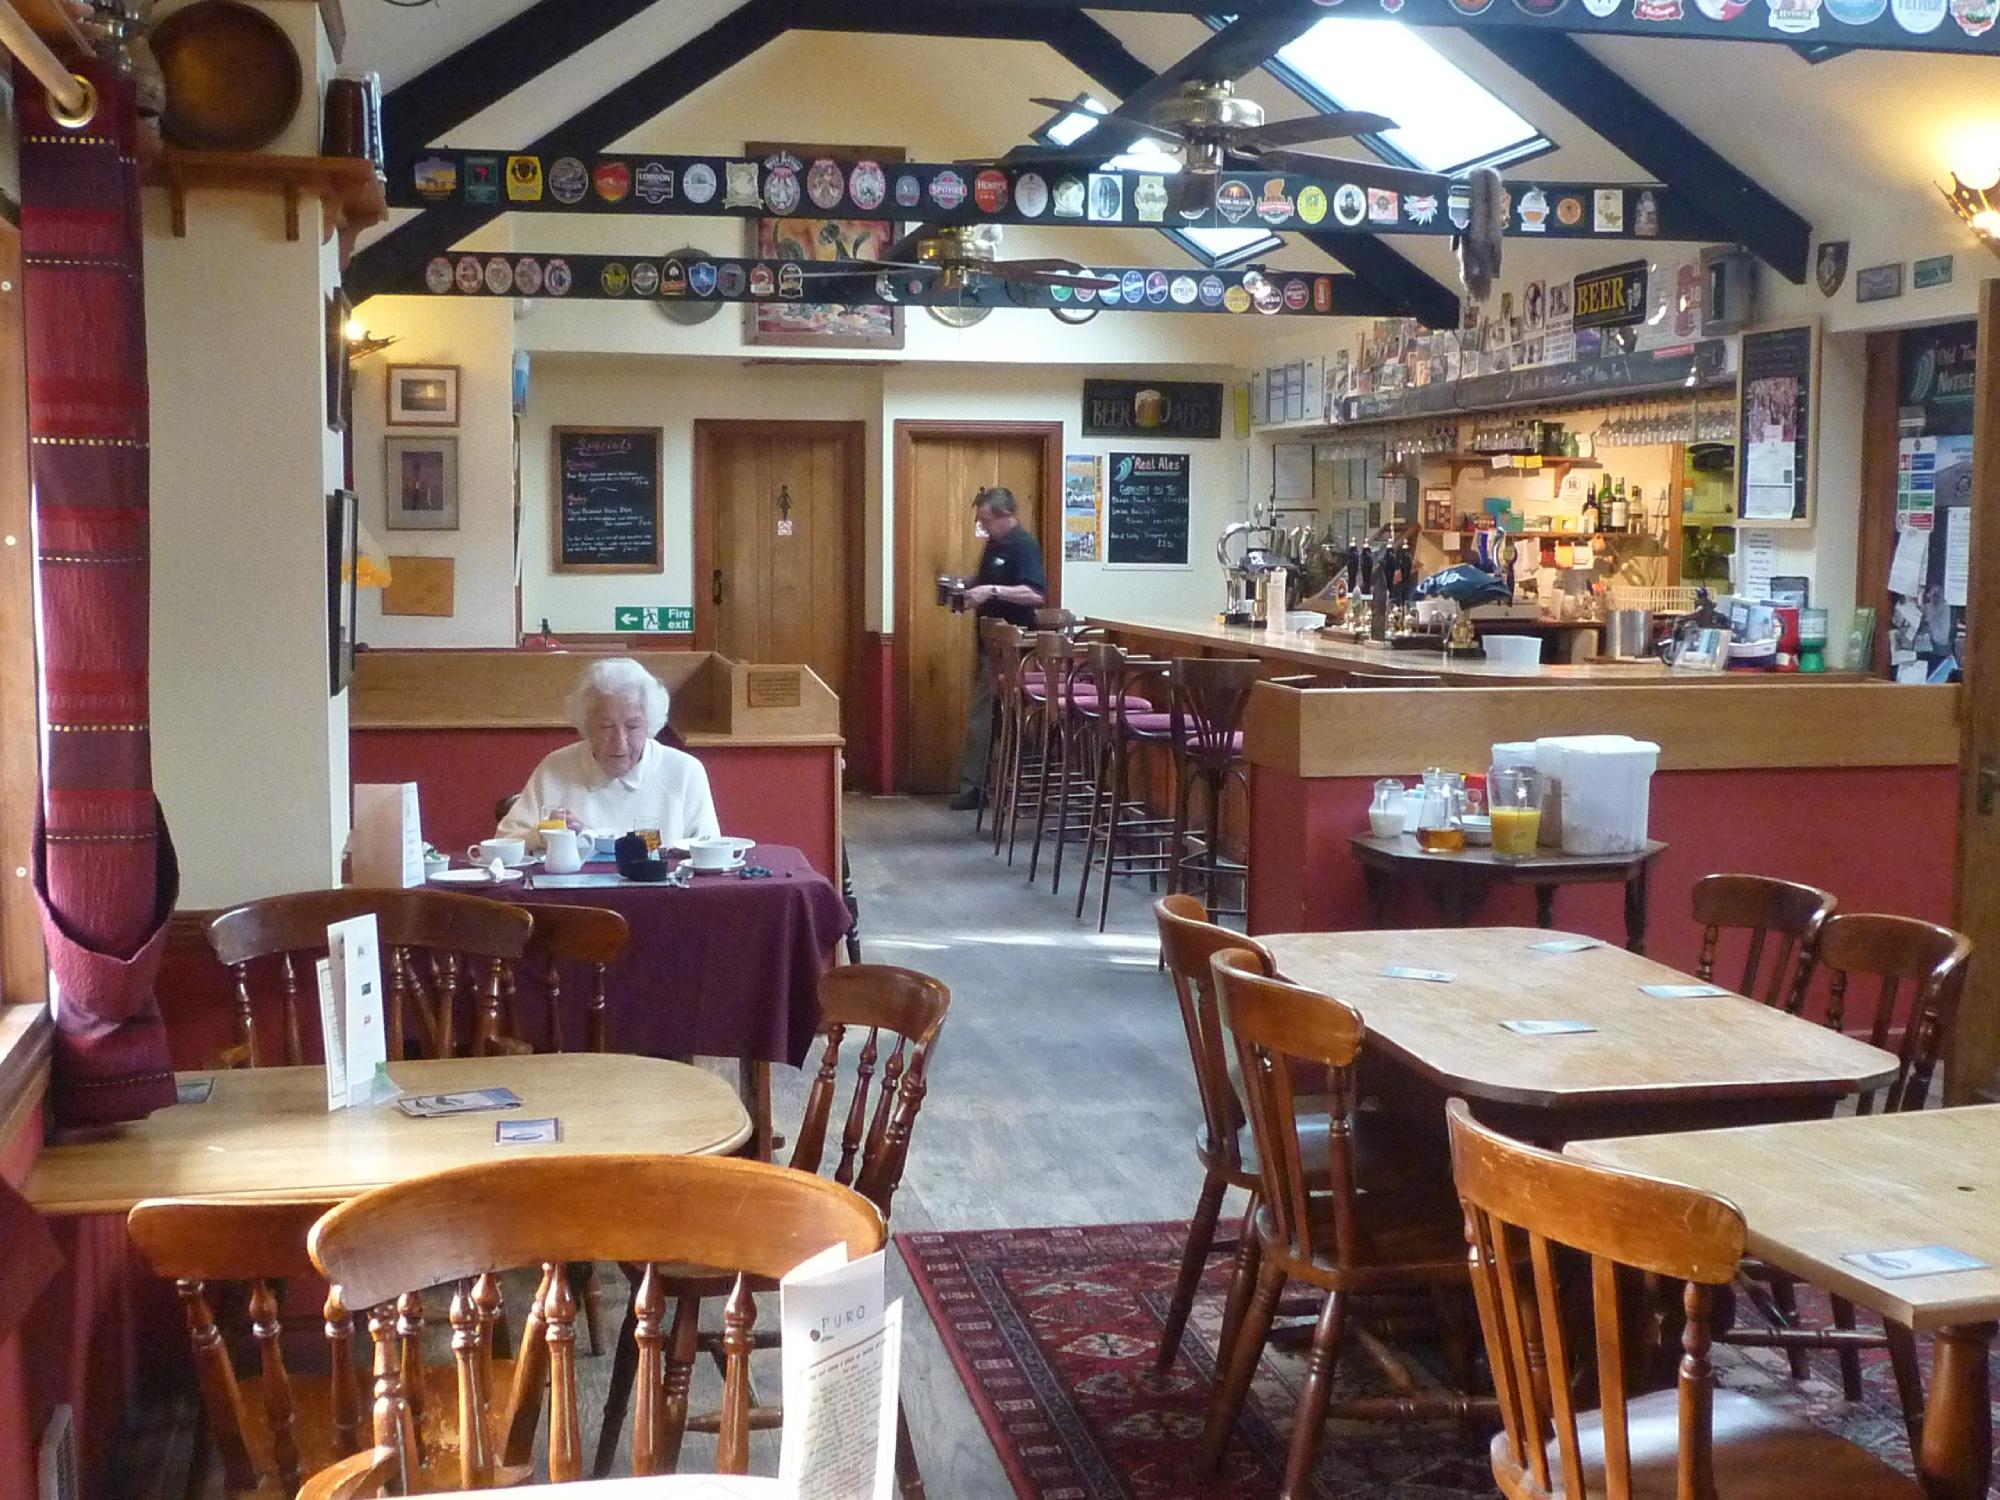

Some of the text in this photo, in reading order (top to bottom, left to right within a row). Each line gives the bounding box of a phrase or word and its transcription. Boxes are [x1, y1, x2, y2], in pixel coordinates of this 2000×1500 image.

[1576, 277, 1625, 316] BEER
[1092, 399, 1132, 427] BEER
[668, 608, 691, 619] Fire
[668, 619, 690, 630] exit
